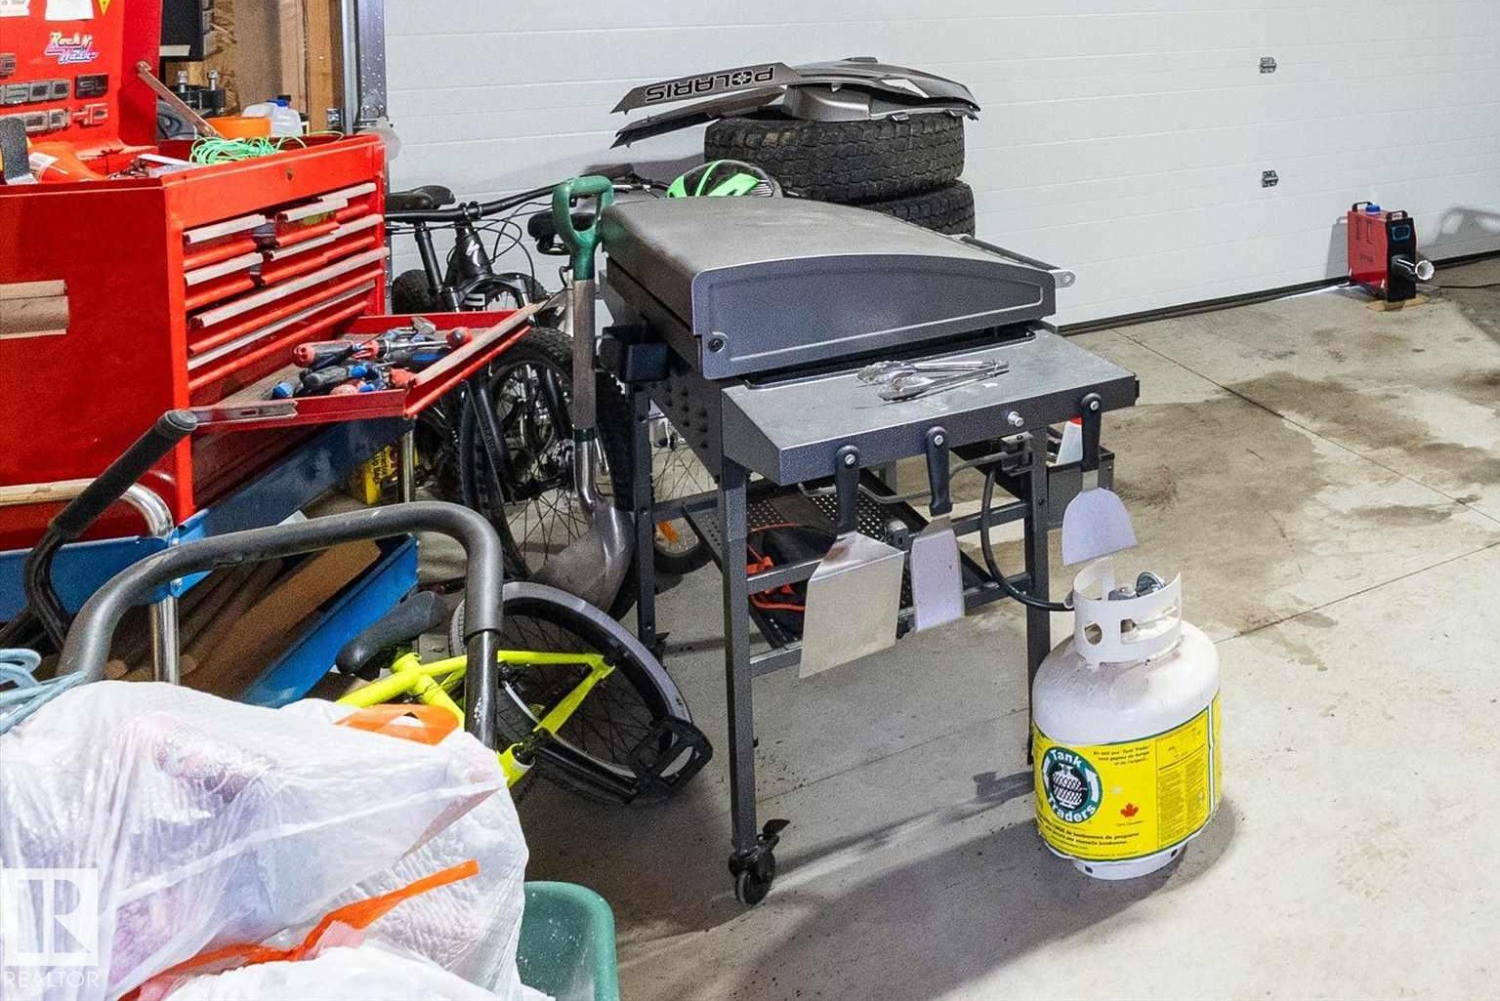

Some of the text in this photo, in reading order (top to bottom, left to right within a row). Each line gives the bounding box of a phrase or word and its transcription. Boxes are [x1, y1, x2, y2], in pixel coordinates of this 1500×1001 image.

[645, 66, 776, 103] POLARIS
[1049, 749, 1084, 768] Tank
[1047, 792, 1097, 823] Traders
